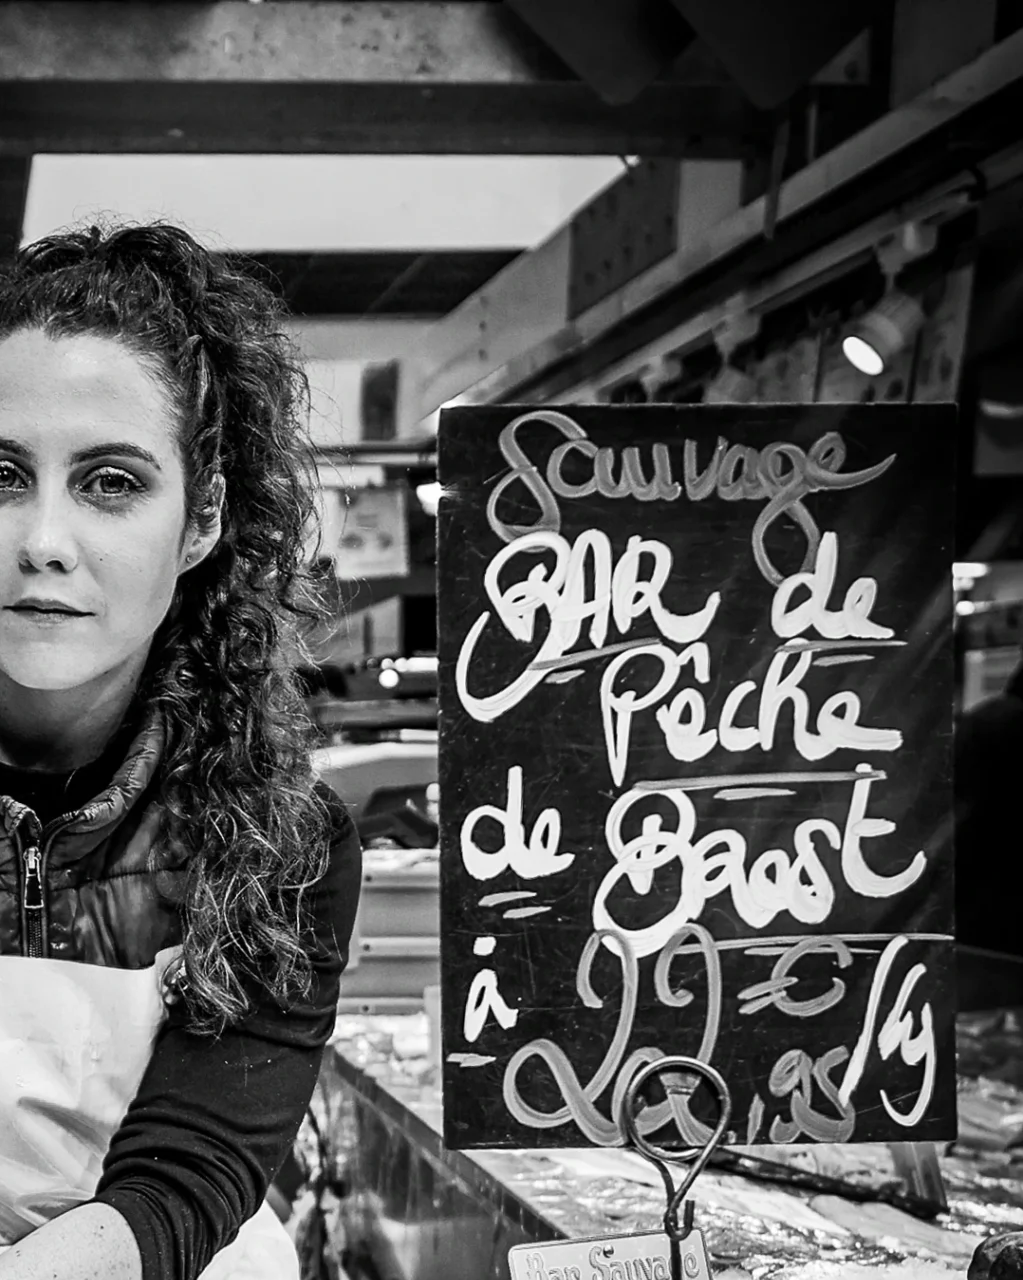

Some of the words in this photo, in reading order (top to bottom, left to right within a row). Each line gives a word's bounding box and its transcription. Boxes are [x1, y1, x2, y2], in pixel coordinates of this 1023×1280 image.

[487, 409, 898, 586] Sauvage
[456, 530, 721, 722] BAR
[772, 532, 895, 639] de
[600, 638, 903, 787] Pêche
[461, 766, 575, 880] de
